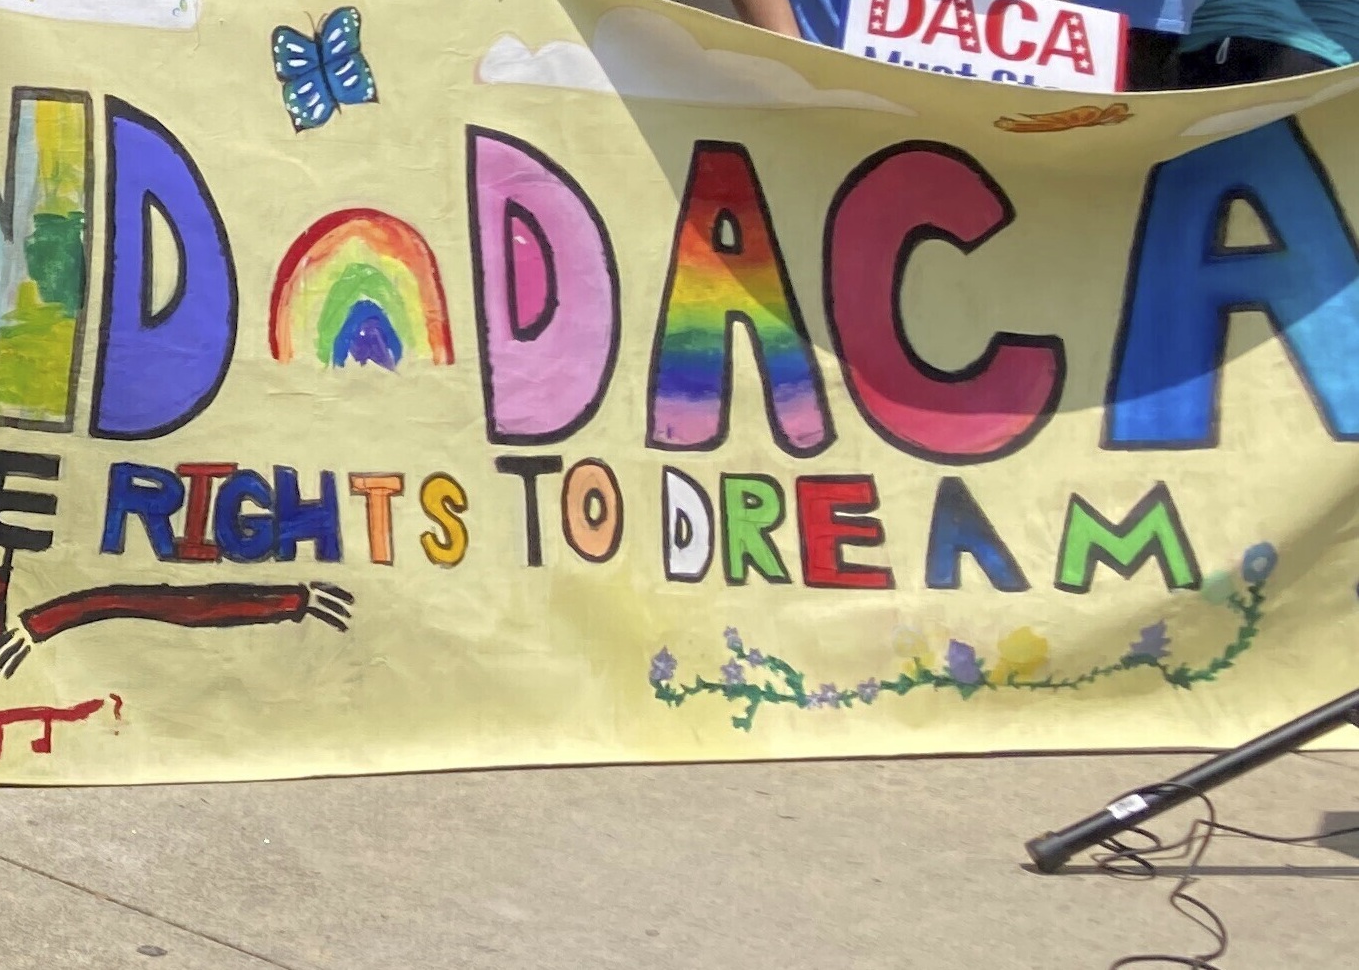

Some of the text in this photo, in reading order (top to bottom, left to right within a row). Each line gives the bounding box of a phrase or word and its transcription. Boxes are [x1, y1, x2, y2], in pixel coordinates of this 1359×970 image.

[466, 115, 1359, 465] DACA
[99, 462, 468, 567] RIGHTS
[496, 456, 623, 567] TO
[662, 464, 1203, 594] DREAM
